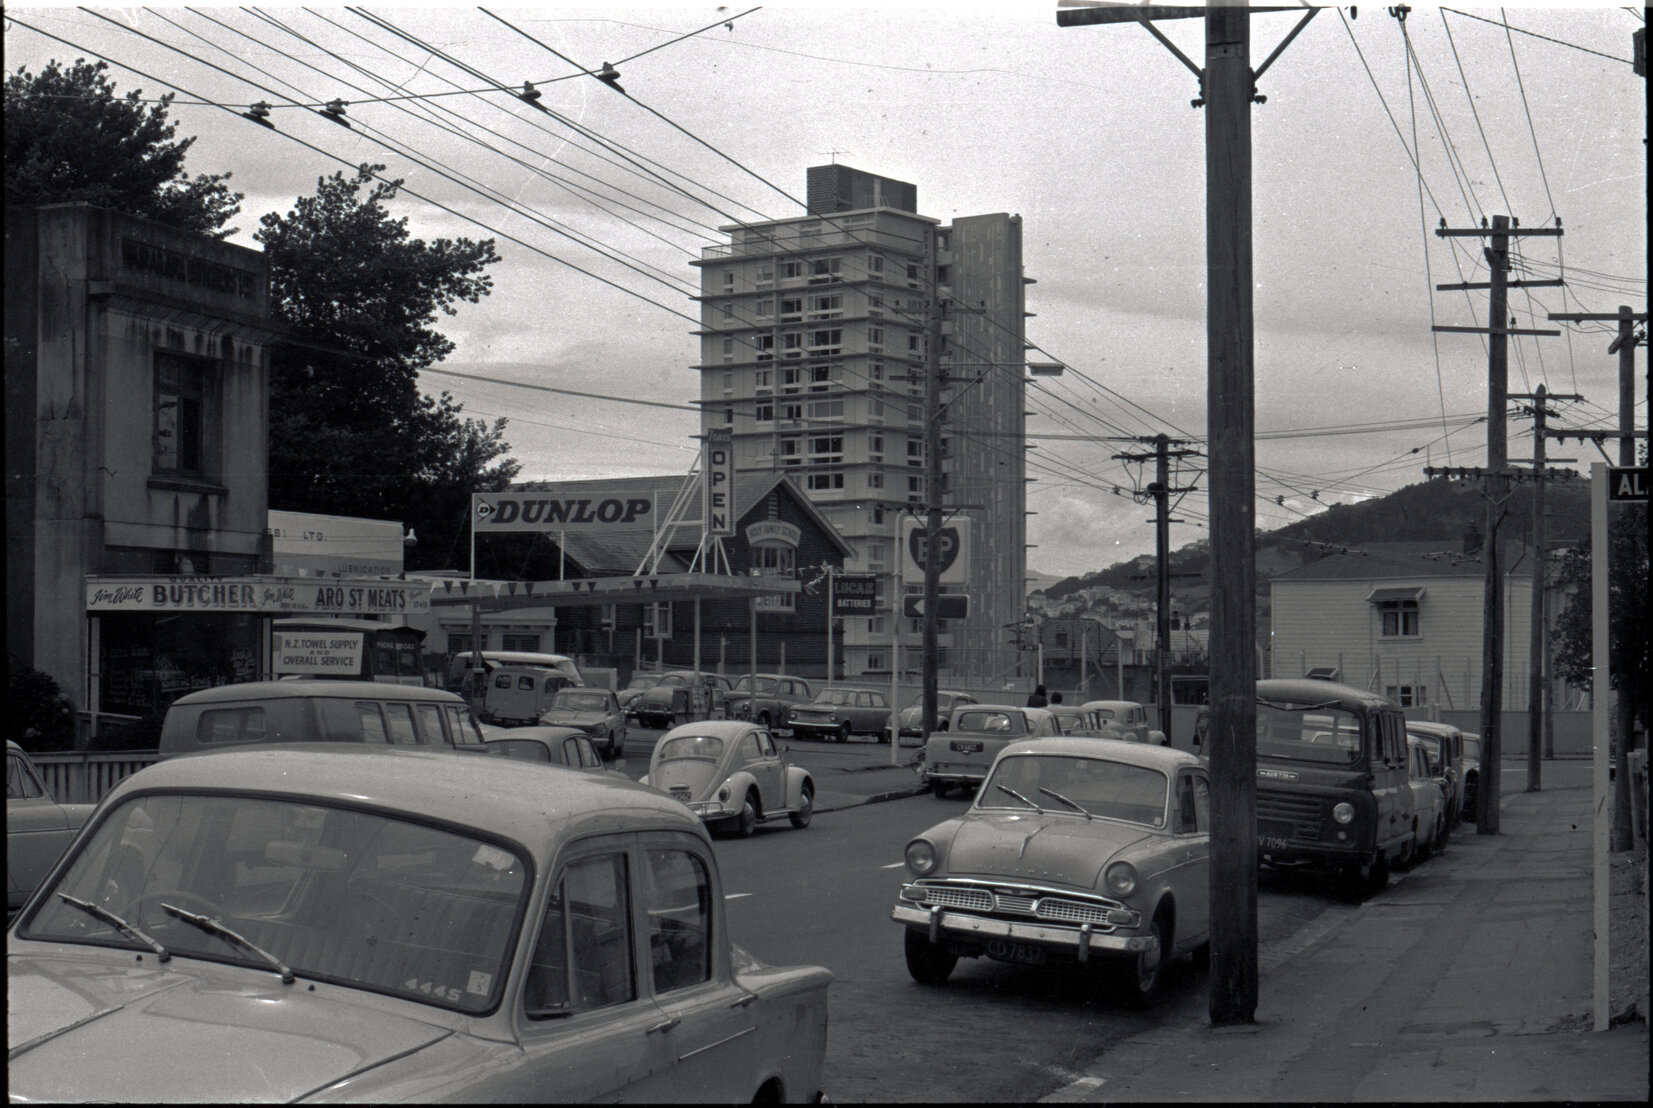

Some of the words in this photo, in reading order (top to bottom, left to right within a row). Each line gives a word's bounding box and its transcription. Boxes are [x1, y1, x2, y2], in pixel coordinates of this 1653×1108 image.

[712, 450, 726, 529] OPEN
[1618, 474, 1648, 495] AL
[490, 499, 651, 523] DUNLOP
[303, 531, 327, 541] LTD.
[338, 564, 391, 575] LUBRICATION
[112, 586, 144, 604] White
[834, 582, 874, 595] LUCAS
[153, 585, 256, 607] BUTCHER
[315, 588, 344, 608] ARO
[368, 589, 406, 610] MEATS
[837, 598, 872, 609] BATTERIES
[330, 639, 358, 649] SUPPLY
[283, 656, 318, 666] OVERALL
[321, 657, 354, 666] SERVICE
[1266, 837, 1288, 850] 7096
